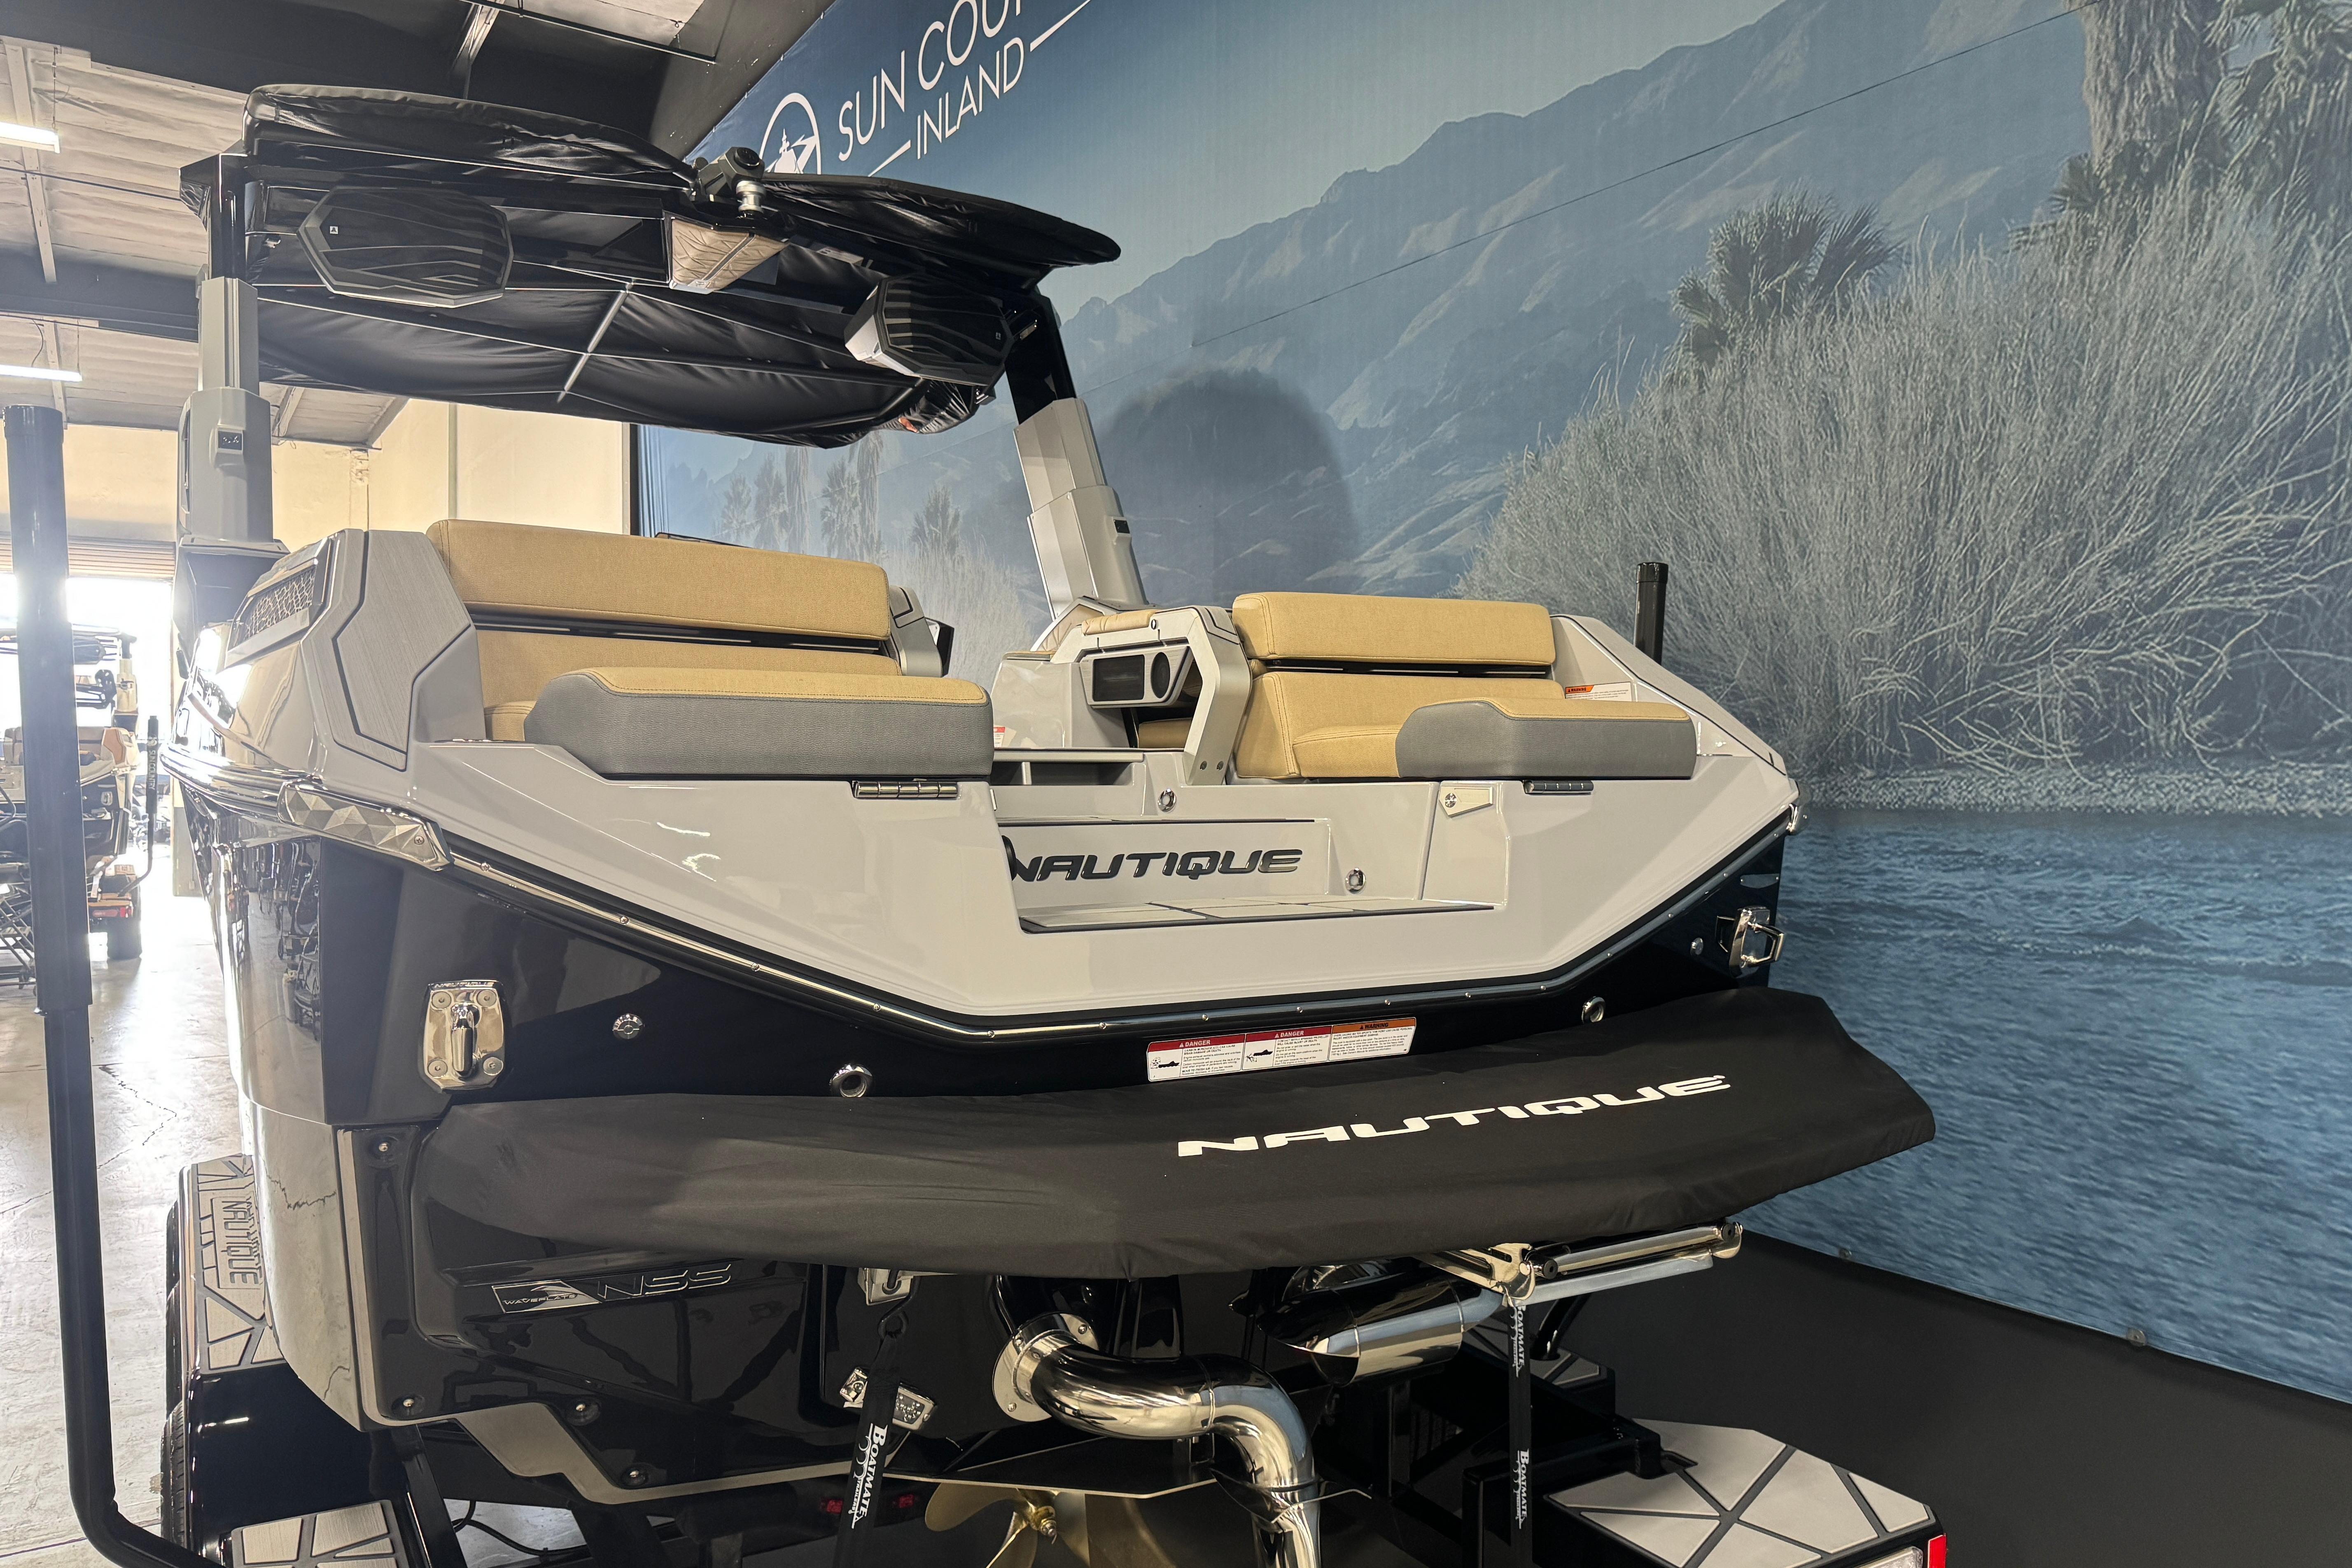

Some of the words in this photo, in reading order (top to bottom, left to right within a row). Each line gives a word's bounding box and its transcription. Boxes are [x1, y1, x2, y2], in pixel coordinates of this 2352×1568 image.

[838, 50, 905, 161] SUN
[918, 0, 1021, 90] COU
[917, 37, 1024, 160] INLAND
[1178, 1075, 1731, 1157] NAUTIQUE
[502, 1293, 577, 1305] WAVEPLATE
[859, 1424, 888, 1517] BOATMATE
[1520, 1448, 1530, 1517] BOATMATE
